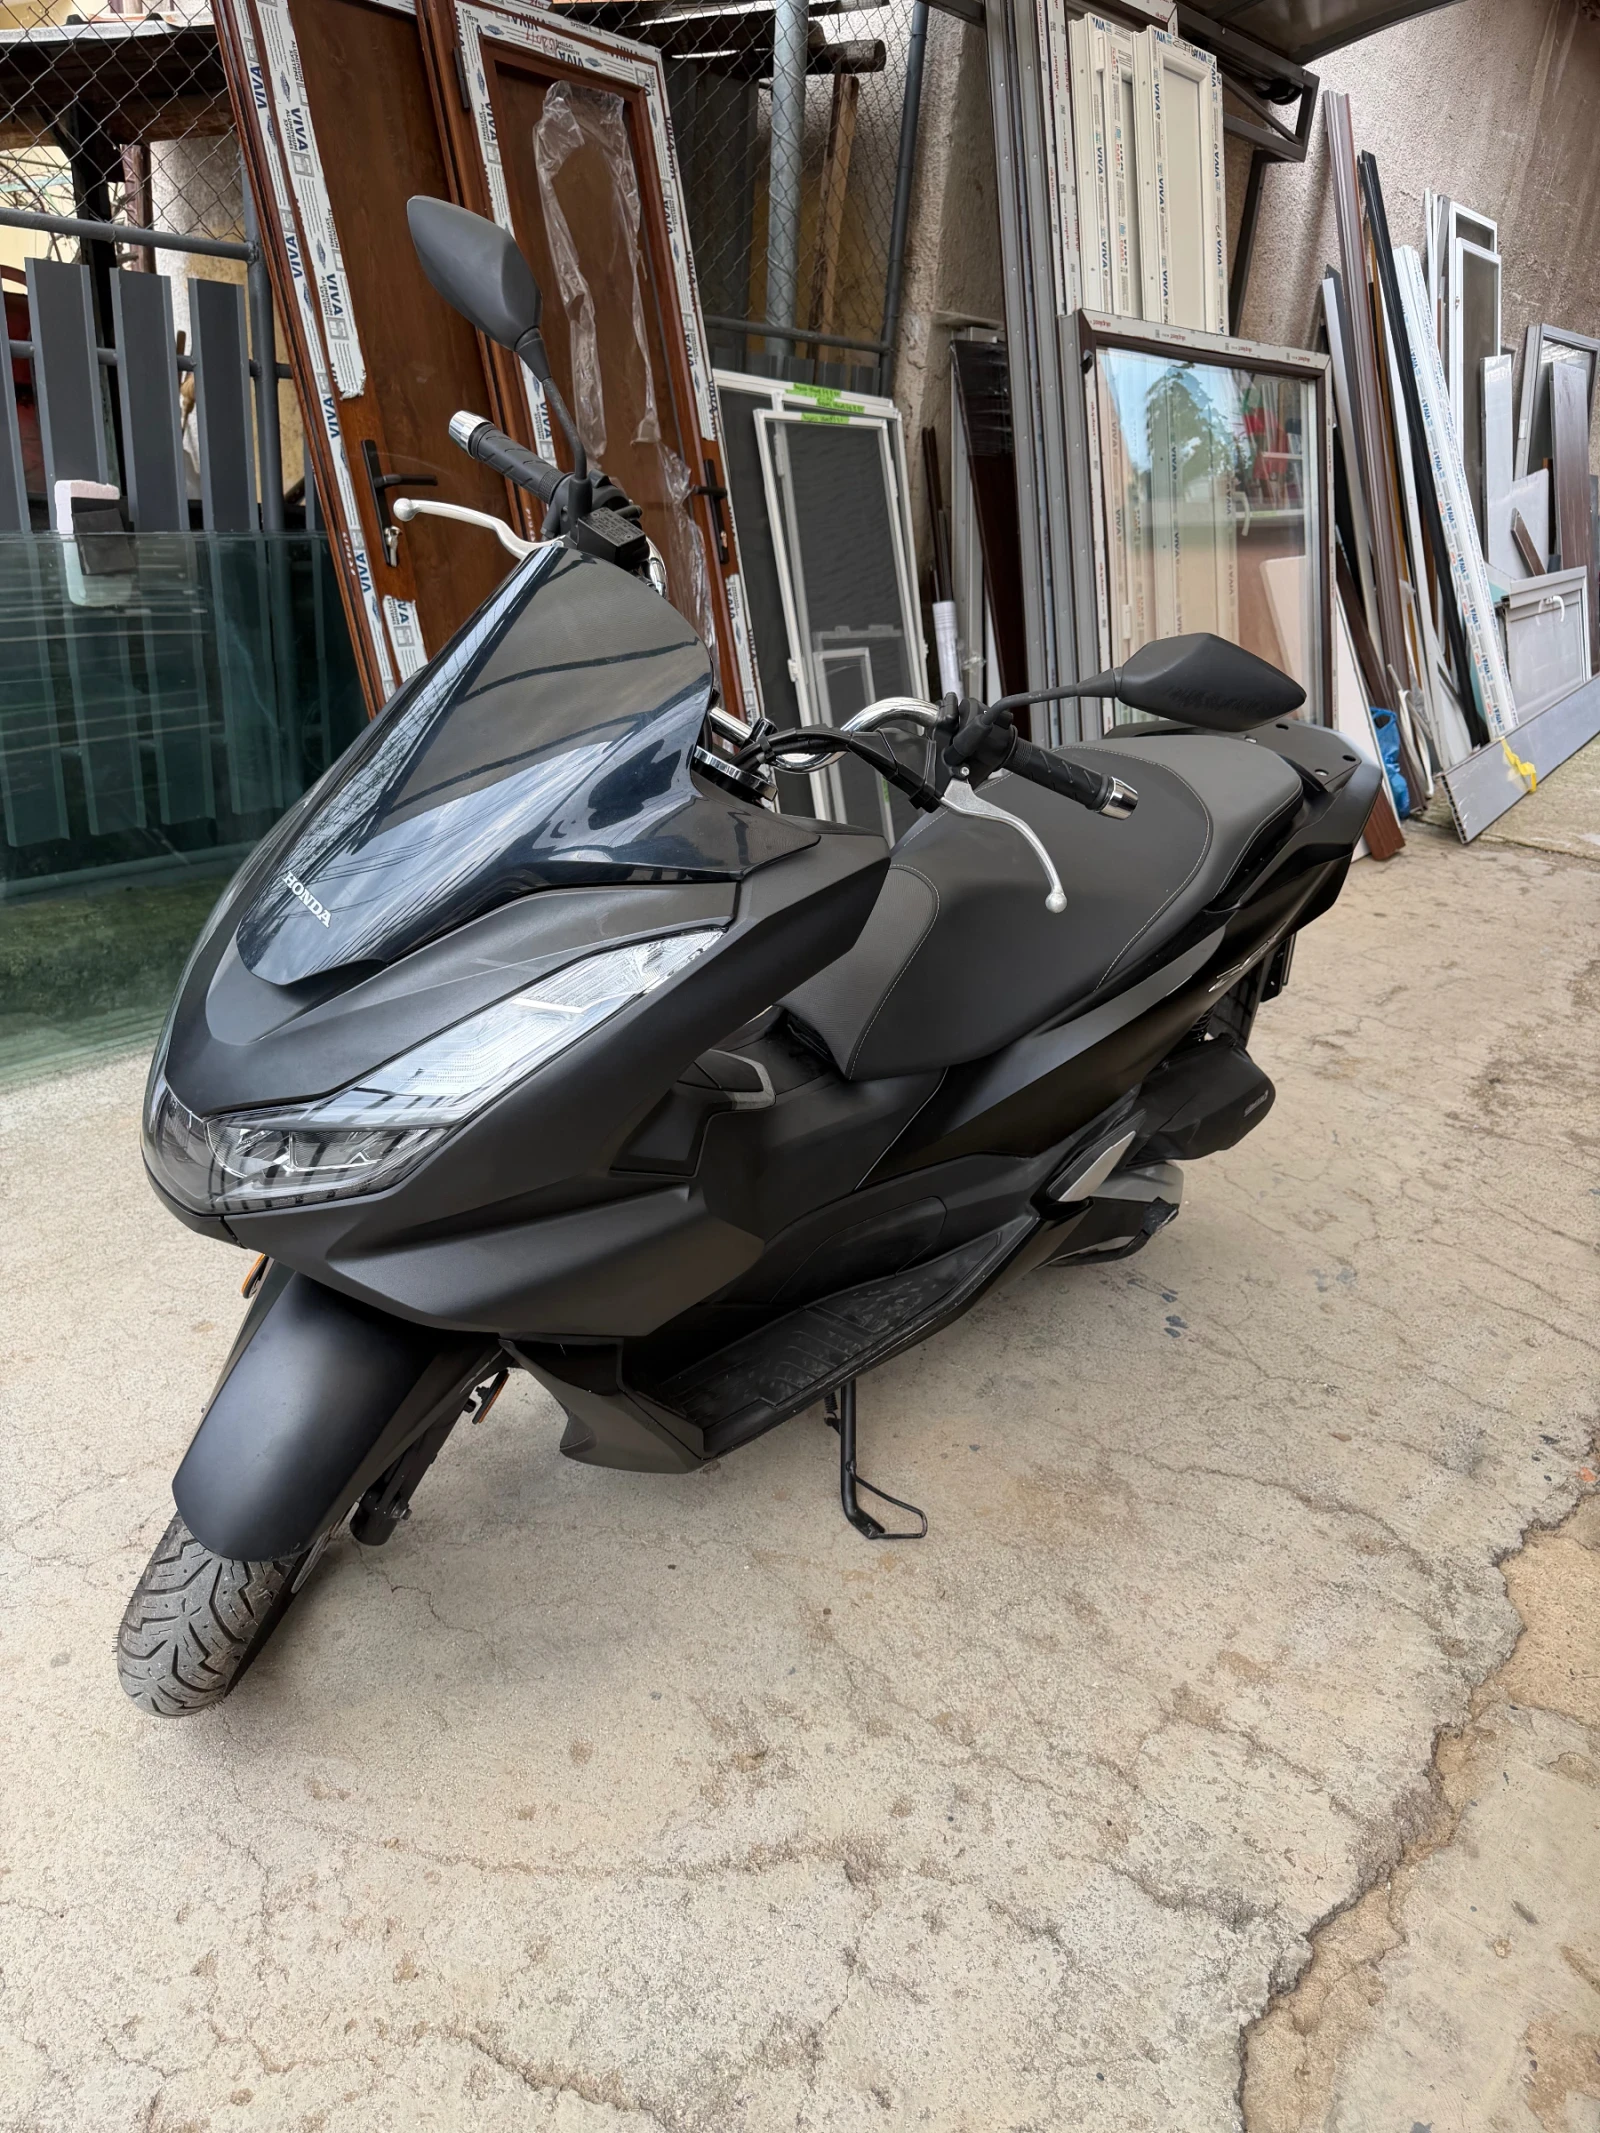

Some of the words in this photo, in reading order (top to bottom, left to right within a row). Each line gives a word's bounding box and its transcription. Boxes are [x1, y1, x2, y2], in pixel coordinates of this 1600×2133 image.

[558, 50, 584, 68] VIVA
[250, 66, 268, 110] VIVA
[290, 107, 308, 151] VIVA
[485, 102, 497, 141] VIVA
[286, 235, 303, 279] VIVA
[327, 273, 343, 316] VIVA
[323, 397, 341, 439] VIVA
[1422, 402, 1430, 421] VIVA
[1111, 421, 1119, 449] VIVA
[1434, 455, 1442, 472] VIVA
[1446, 506, 1455, 523] VIVA
[356, 552, 372, 593] VIVA
[1470, 607, 1478, 625] VIVA
[1482, 658, 1490, 676] VIVA
[1493, 708, 1502, 725] VIVA
[282, 870, 333, 929] HONDA
